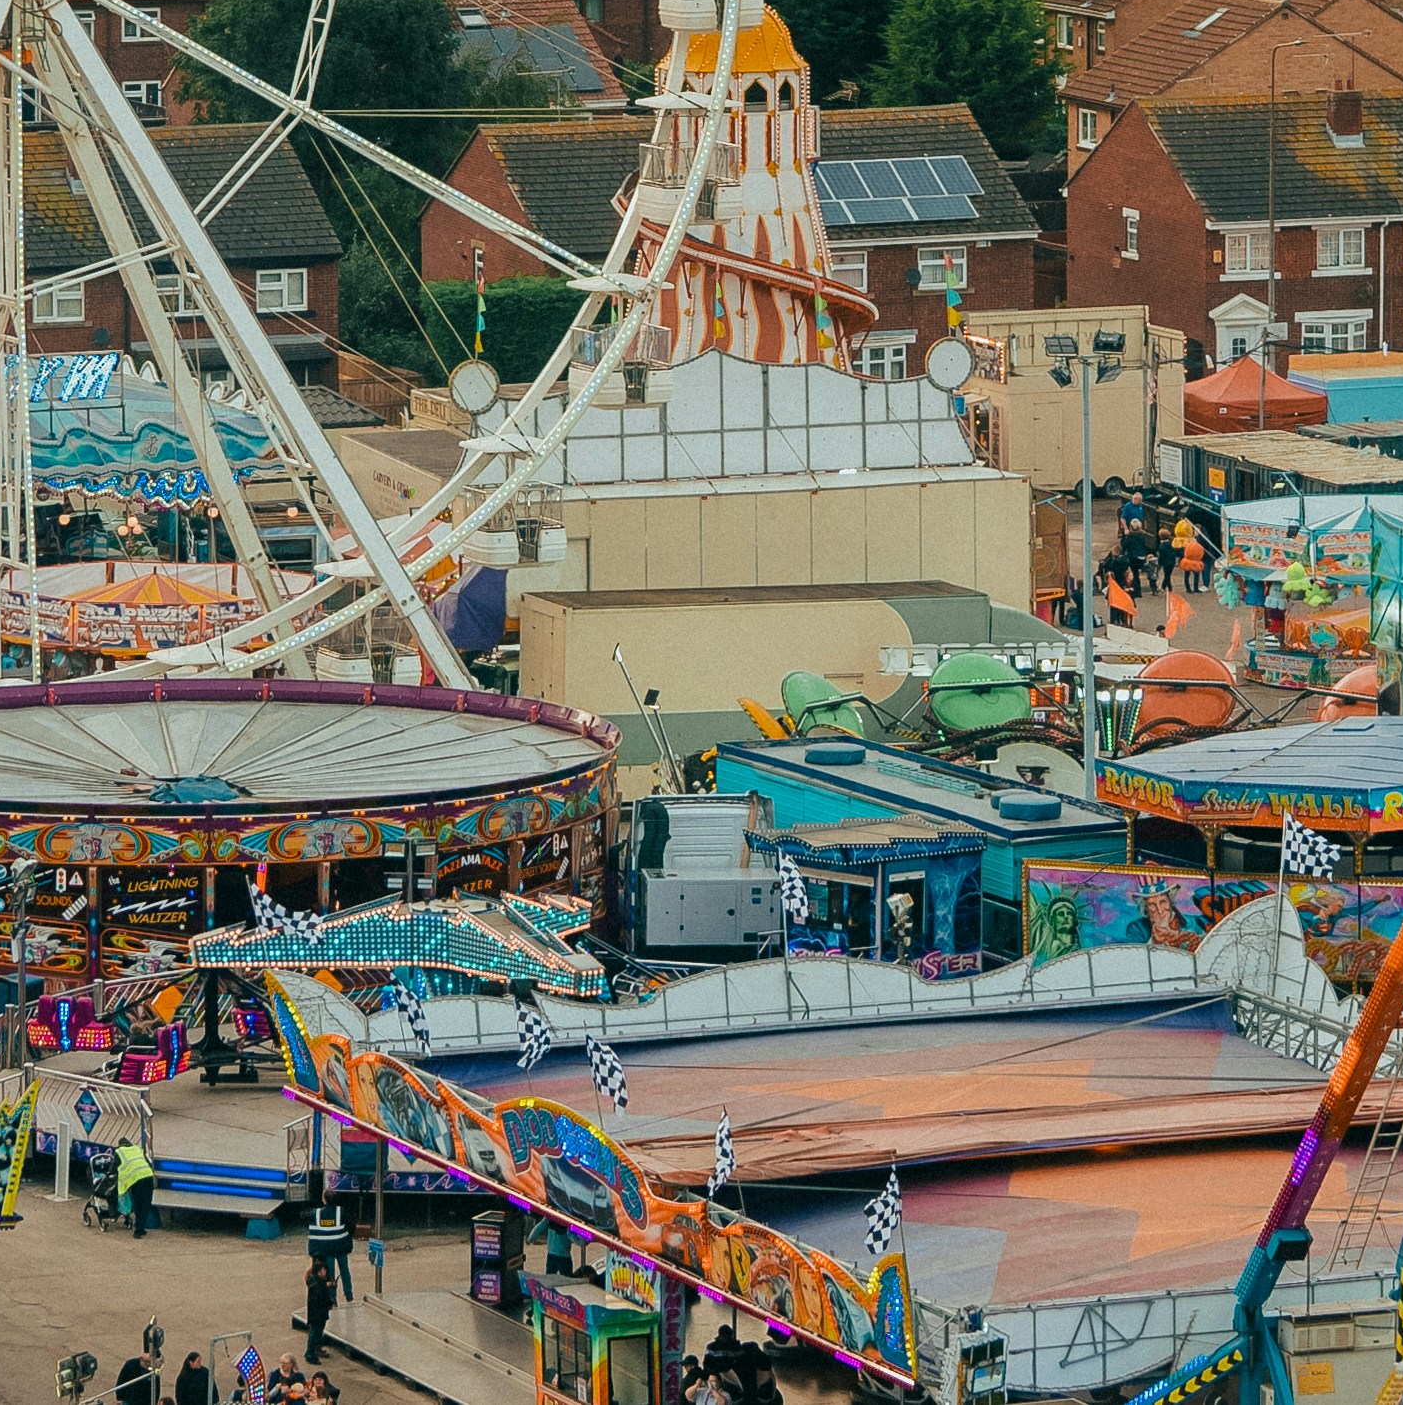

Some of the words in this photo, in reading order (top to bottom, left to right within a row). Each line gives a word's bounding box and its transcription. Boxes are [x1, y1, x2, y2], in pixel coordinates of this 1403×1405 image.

[413, 396, 429, 412] THE
[1103, 765, 1176, 810] ROTOR
[1269, 792, 1363, 820] WALL
[436, 853, 504, 880] RAZZAMATAZZ
[127, 875, 200, 894] LIGHTNING
[36, 894, 73, 907] SOUNDS
[128, 910, 188, 924] WALTZER
[501, 1106, 649, 1232] DODGEMS
[540, 1287, 554, 1302] PAY
[663, 1279, 682, 1352] UMPER
